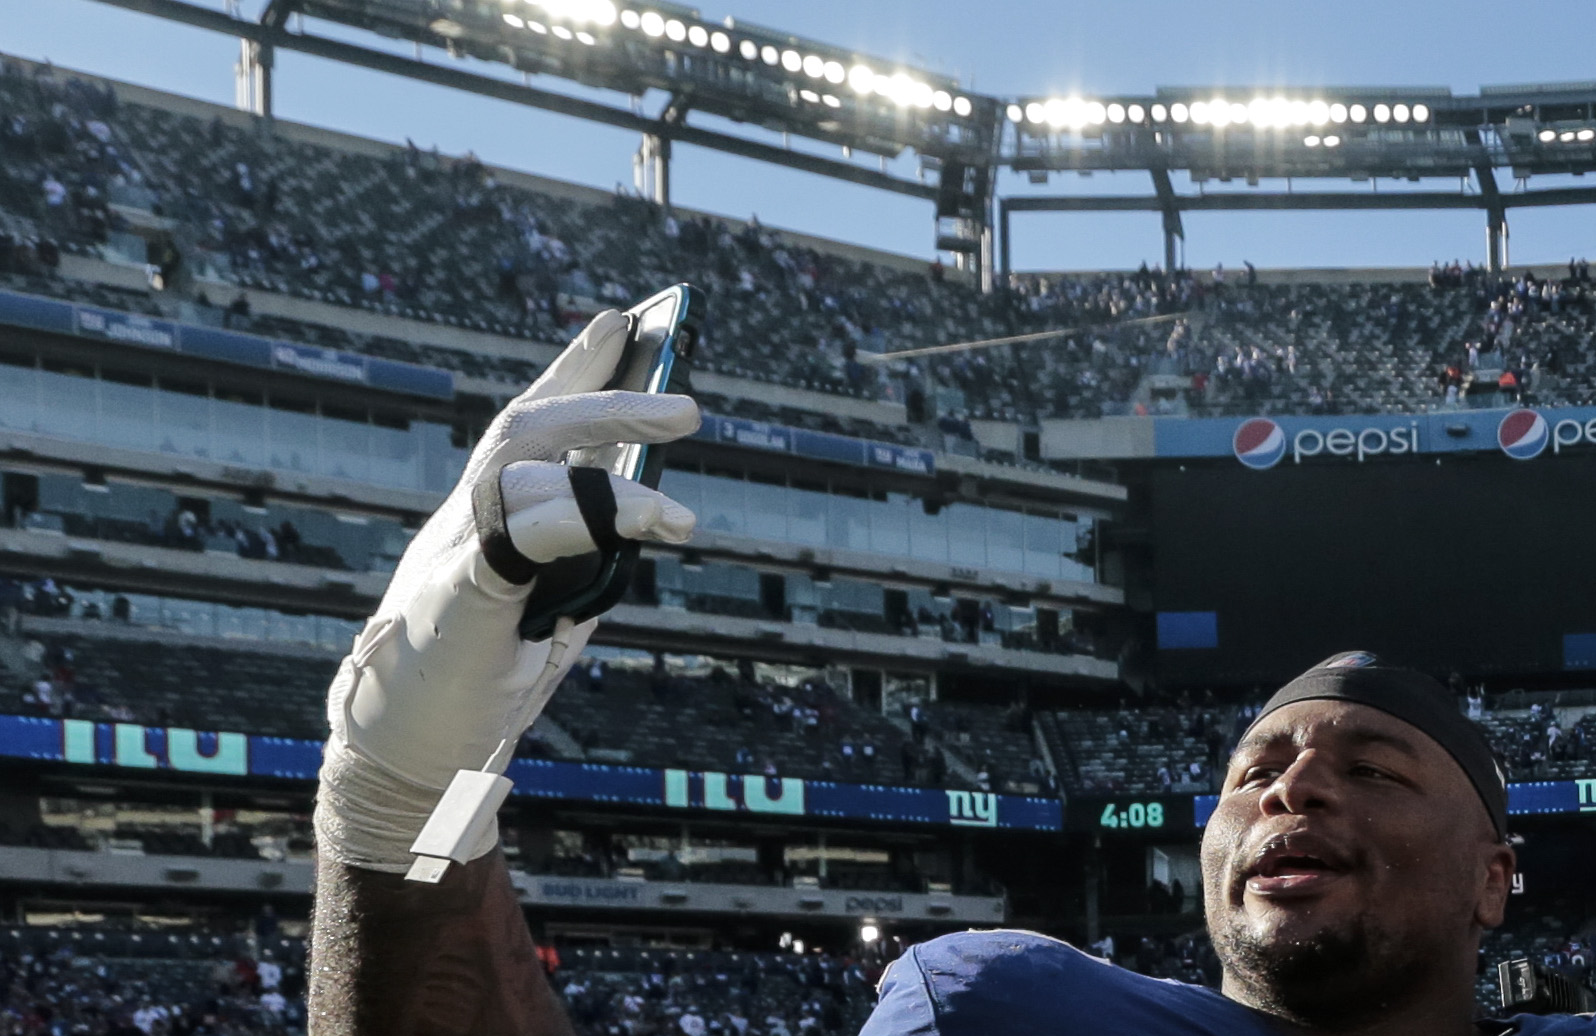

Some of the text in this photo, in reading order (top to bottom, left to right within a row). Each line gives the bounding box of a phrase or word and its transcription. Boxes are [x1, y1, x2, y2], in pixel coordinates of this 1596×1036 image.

[1294, 420, 1419, 464] pepsi
[945, 790, 997, 828] ny
[1100, 802, 1164, 828] 4:08
[585, 885, 638, 899] LIGHT
[845, 897, 903, 914] pepsi
